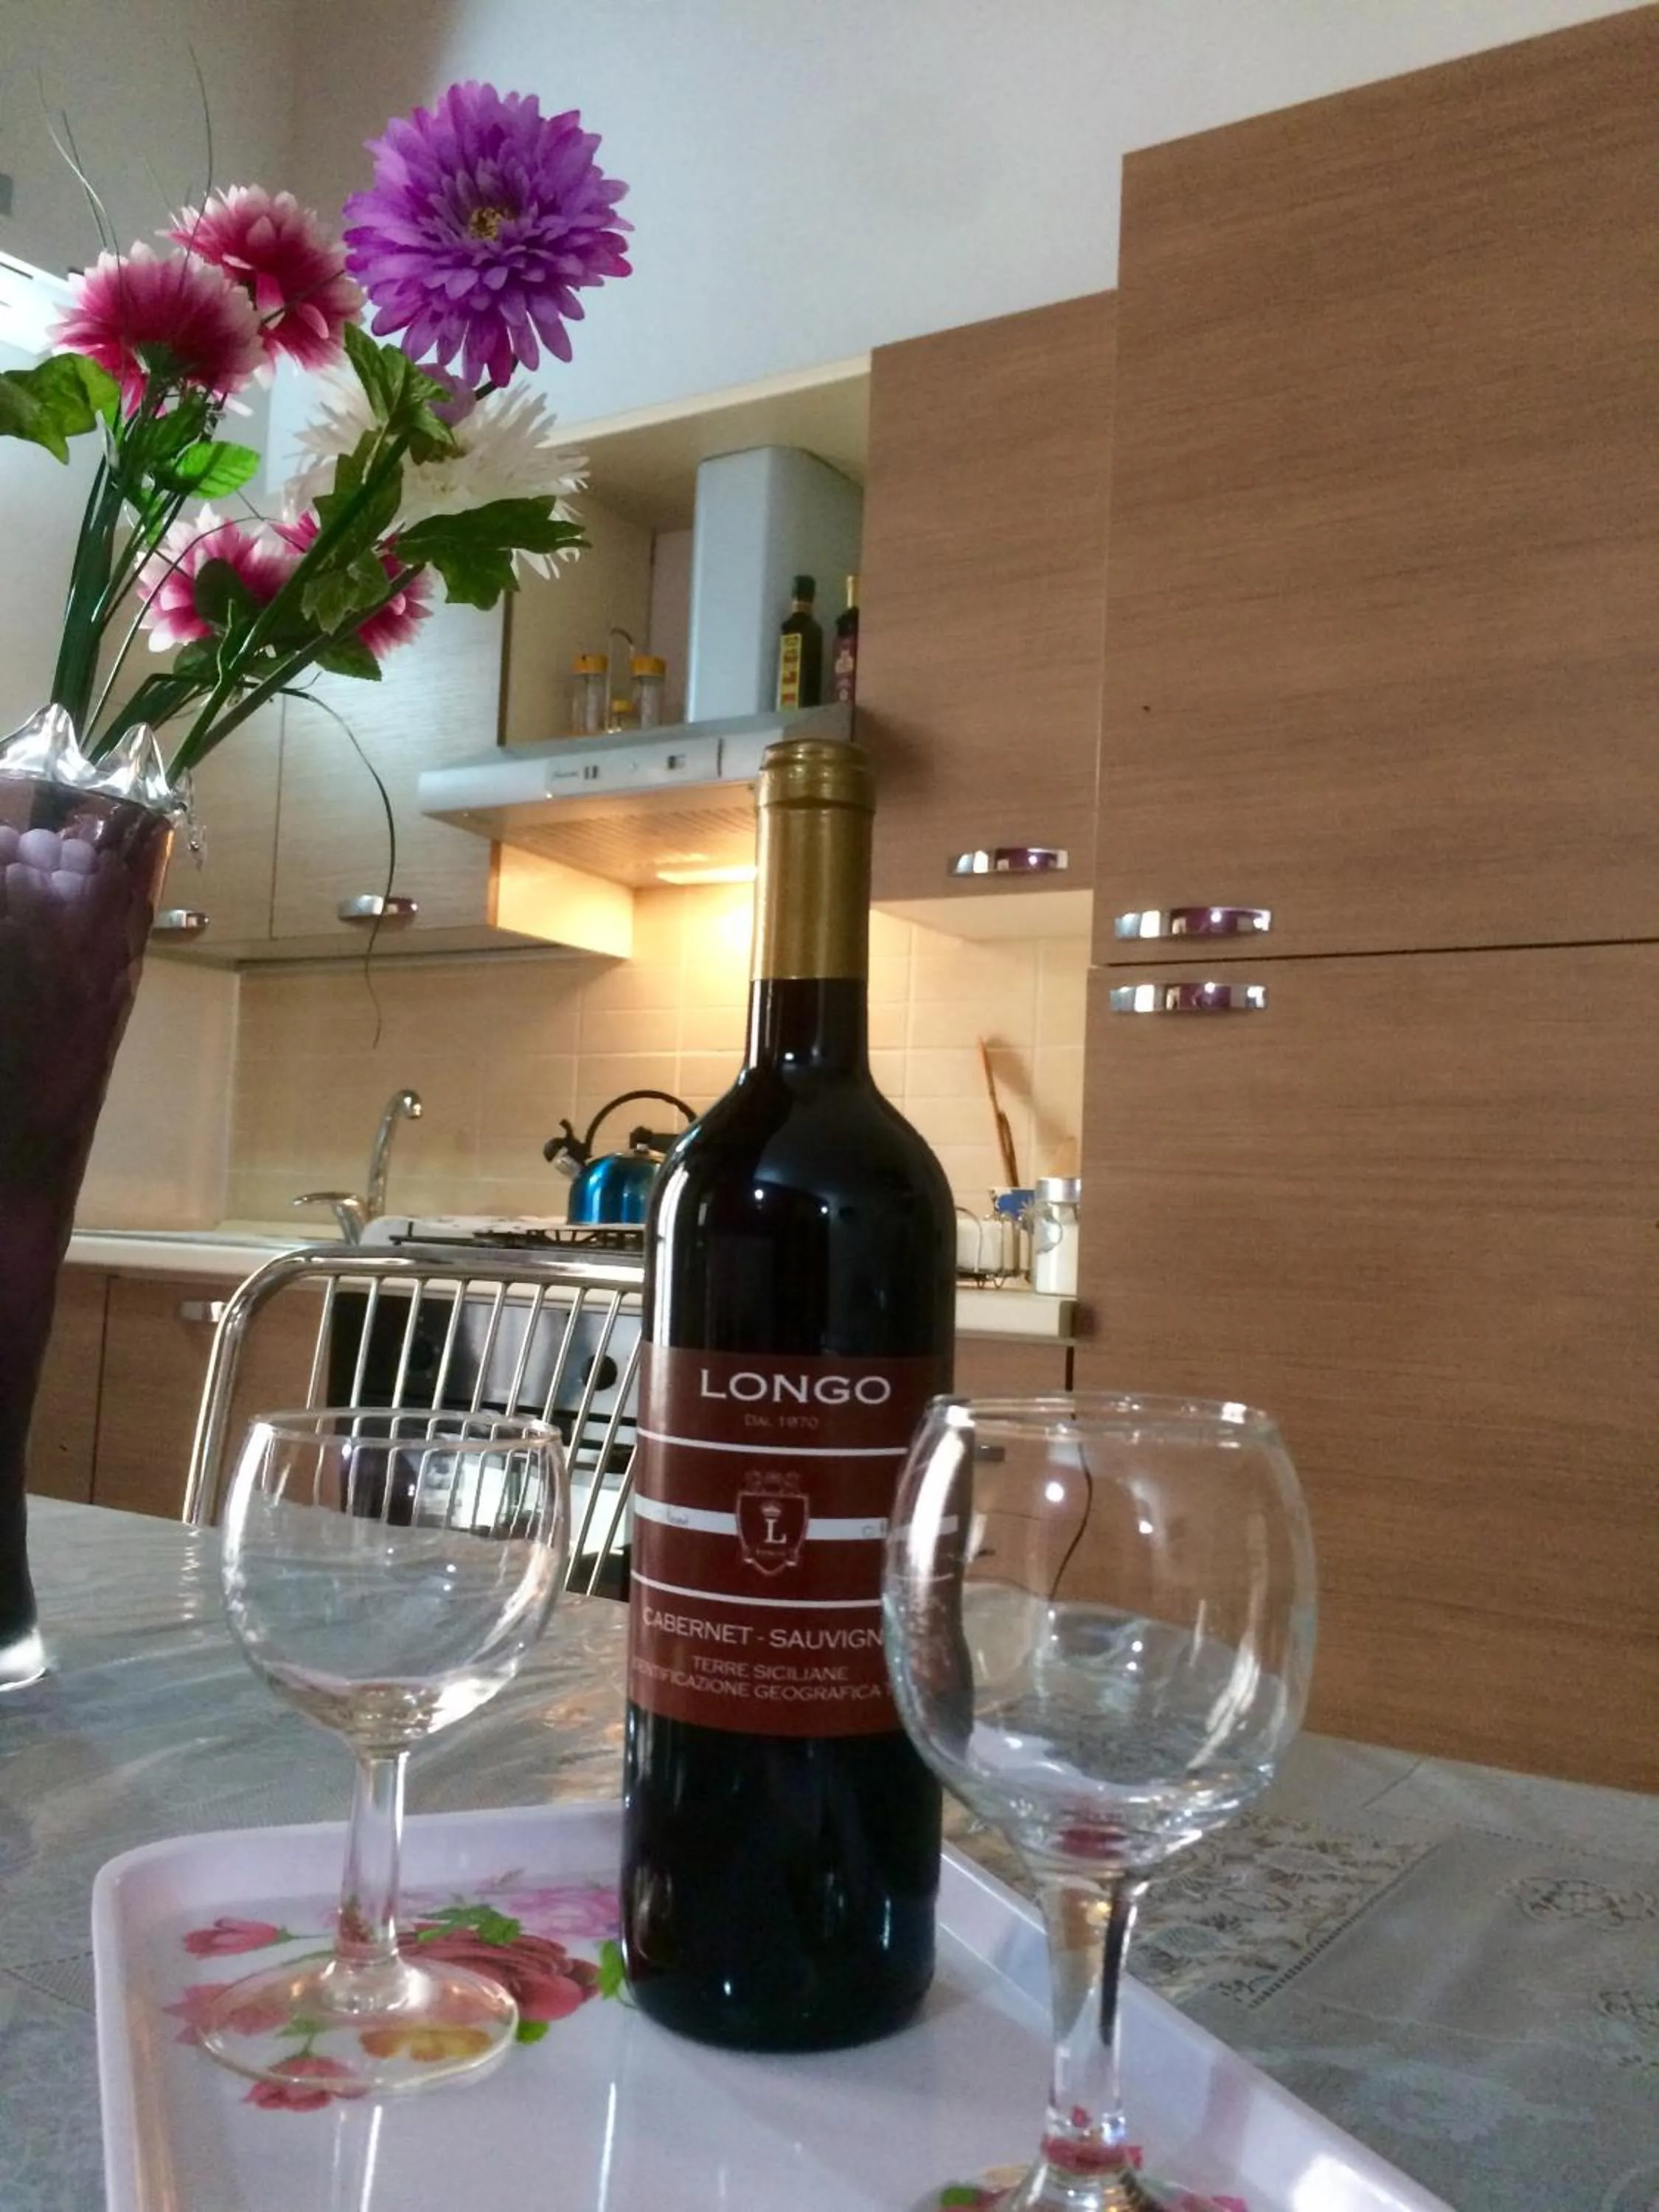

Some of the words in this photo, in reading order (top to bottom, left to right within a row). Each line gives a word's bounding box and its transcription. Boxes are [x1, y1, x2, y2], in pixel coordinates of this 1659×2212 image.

[700, 1368, 891, 1405] LONGO
[779, 1414, 820, 1430] 1870
[764, 1518, 787, 1544] L
[642, 1606, 754, 1645] CABERNET
[693, 1656, 750, 1677] TERRE
[753, 1663, 849, 1682] SICILIANE
[754, 1683, 882, 1701] GEOGRAFICA
